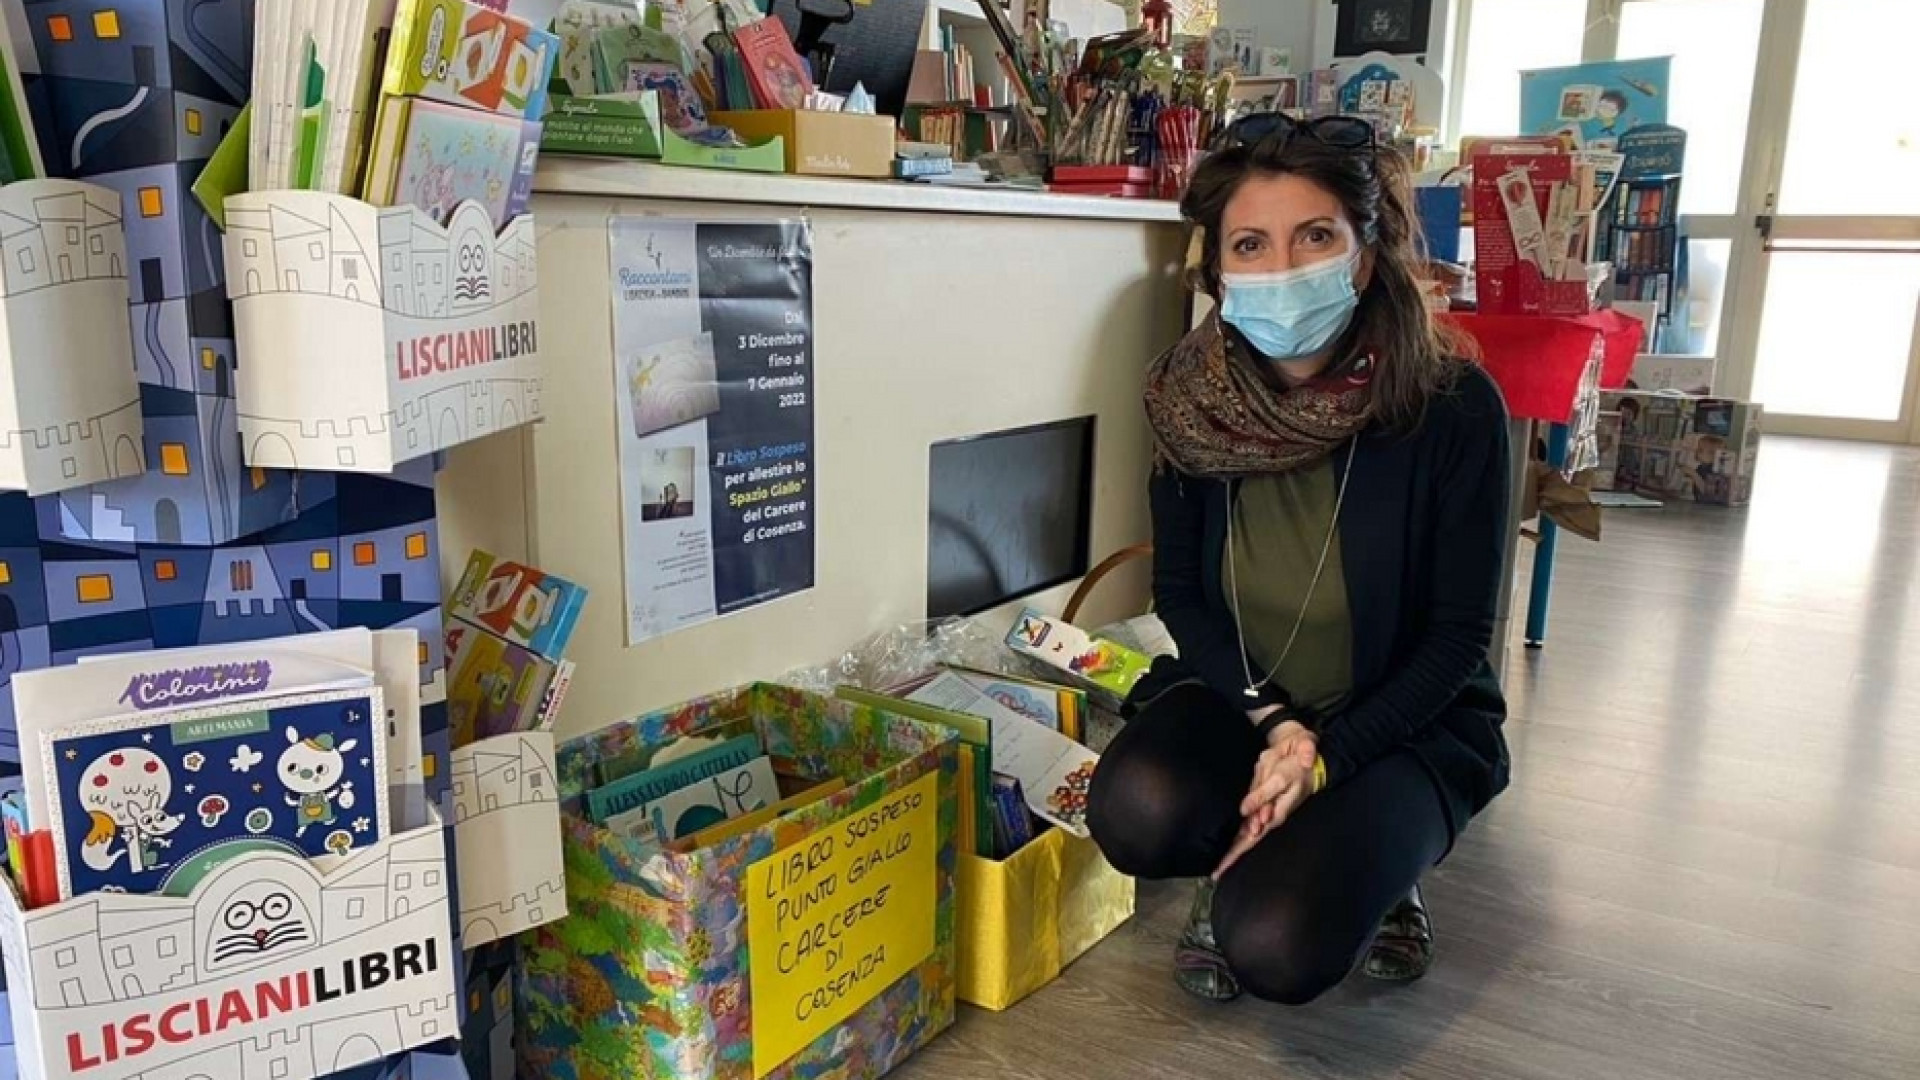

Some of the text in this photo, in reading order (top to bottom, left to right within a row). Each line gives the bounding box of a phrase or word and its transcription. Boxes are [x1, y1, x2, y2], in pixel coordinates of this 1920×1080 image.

[784, 310, 804, 324] Dal
[396, 320, 537, 380] LISCIANILIBRI
[737, 332, 805, 349] 3 Dicembre
[768, 352, 805, 368] fino al
[748, 372, 805, 391] 7 Gennaio
[779, 392, 806, 408] 2022
[727, 447, 757, 465] Libro
[760, 442, 806, 459] Sospeso
[725, 459, 806, 490] per allestire lo
[729, 486, 768, 507] Spazio
[743, 500, 806, 524] del Carcere
[743, 520, 807, 544] di Cosenza.
[139, 667, 262, 702] Colorini
[187, 718, 254, 737] ARTEMANIA
[767, 792, 922, 899] LIBRO SOSPESO
[777, 832, 911, 932] PUNTO GIALLO
[778, 884, 891, 974] CARCERE
[825, 941, 844, 973] DI
[795, 944, 886, 1021] COSENZA
[65, 937, 438, 1072] LISCIANILIBRI
